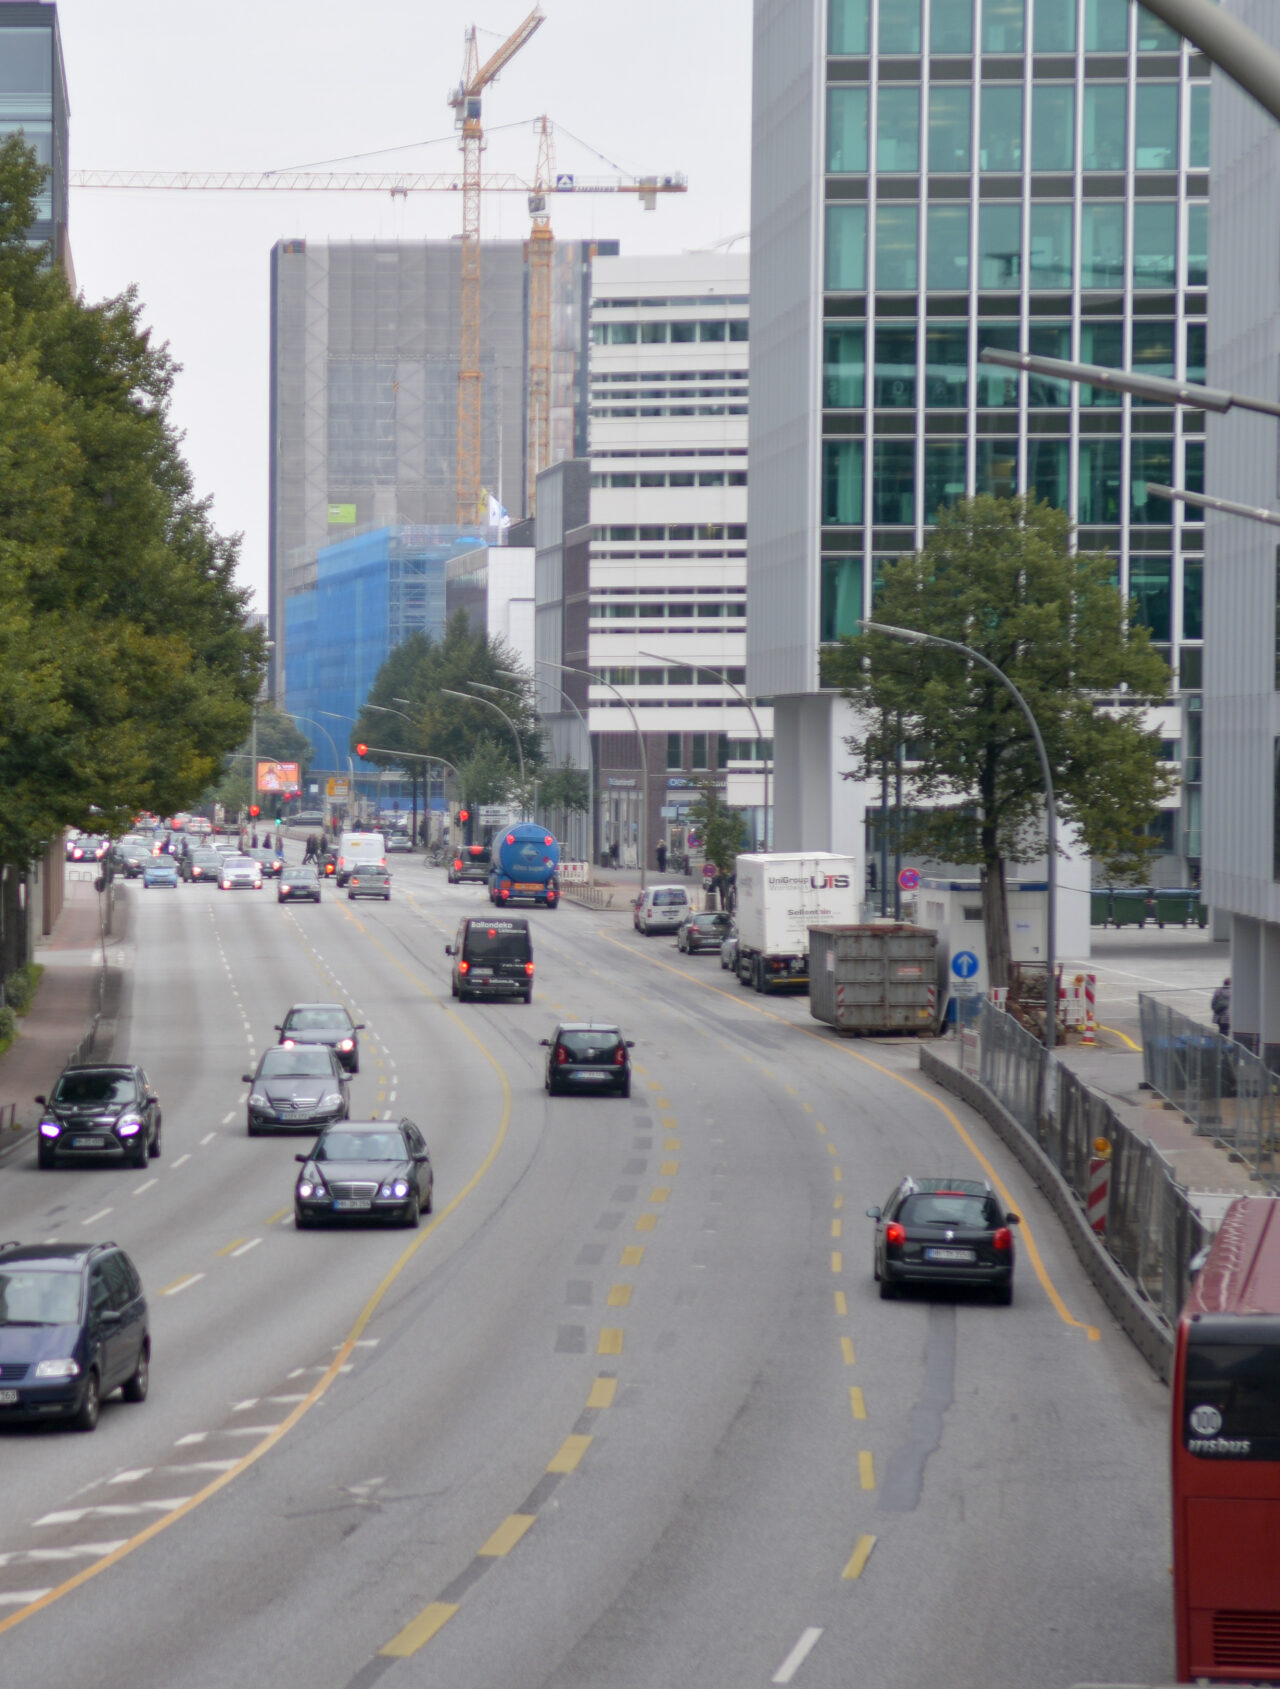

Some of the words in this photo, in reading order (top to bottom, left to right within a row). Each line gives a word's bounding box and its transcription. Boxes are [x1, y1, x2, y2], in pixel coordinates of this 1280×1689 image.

[768, 876, 809, 885] UniGroup
[810, 874, 850, 889] UTS
[471, 921, 513, 929] Ballondeko
